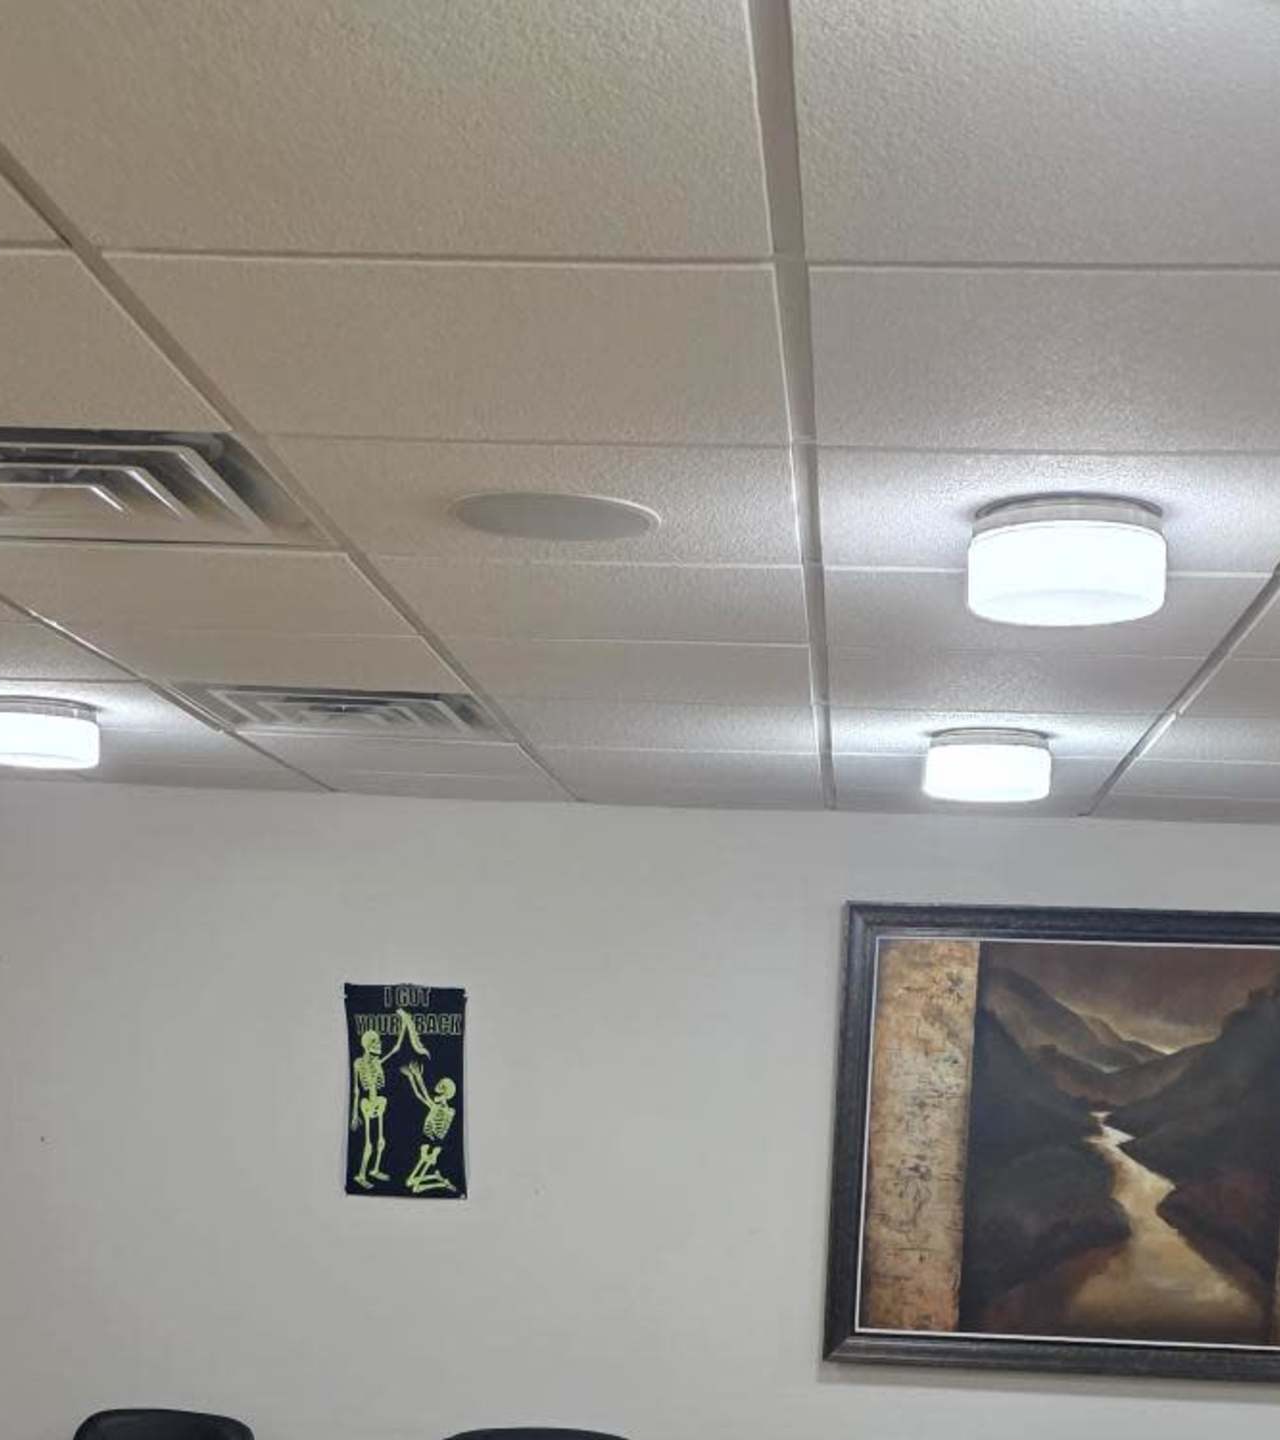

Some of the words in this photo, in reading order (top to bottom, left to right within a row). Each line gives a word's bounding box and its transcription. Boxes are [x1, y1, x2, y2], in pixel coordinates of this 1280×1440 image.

[384, 986, 392, 1008] I
[354, 1013, 400, 1035] YOUR
[414, 1013, 462, 1035] BACK
